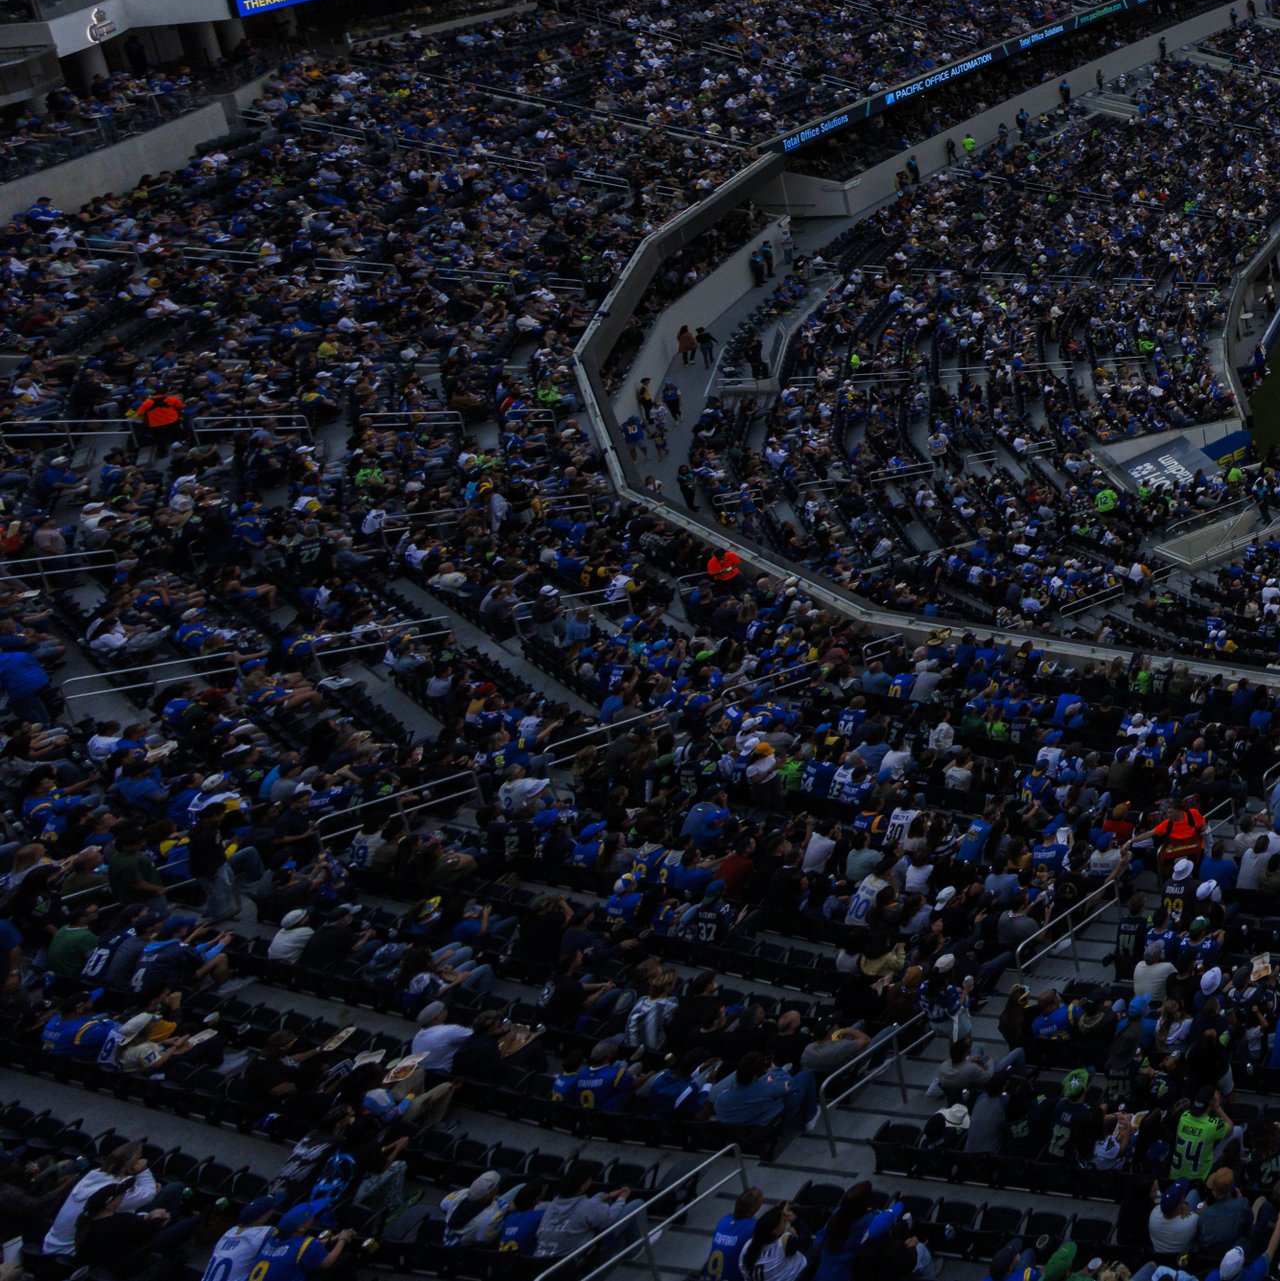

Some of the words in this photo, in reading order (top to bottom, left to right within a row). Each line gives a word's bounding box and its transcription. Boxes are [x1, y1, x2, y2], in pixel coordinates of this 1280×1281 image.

[896, 81, 923, 100] PACIFIC
[925, 71, 949, 88] OFFICE
[951, 53, 992, 78] AUTOMATION
[783, 135, 800, 150] Total
[801, 127, 820, 142] Office
[820, 114, 848, 133] Solutions
[697, 921, 717, 942] 37
[579, 1089, 596, 1108] 9
[1171, 1138, 1201, 1172] 54
[706, 1249, 725, 1281] 9
